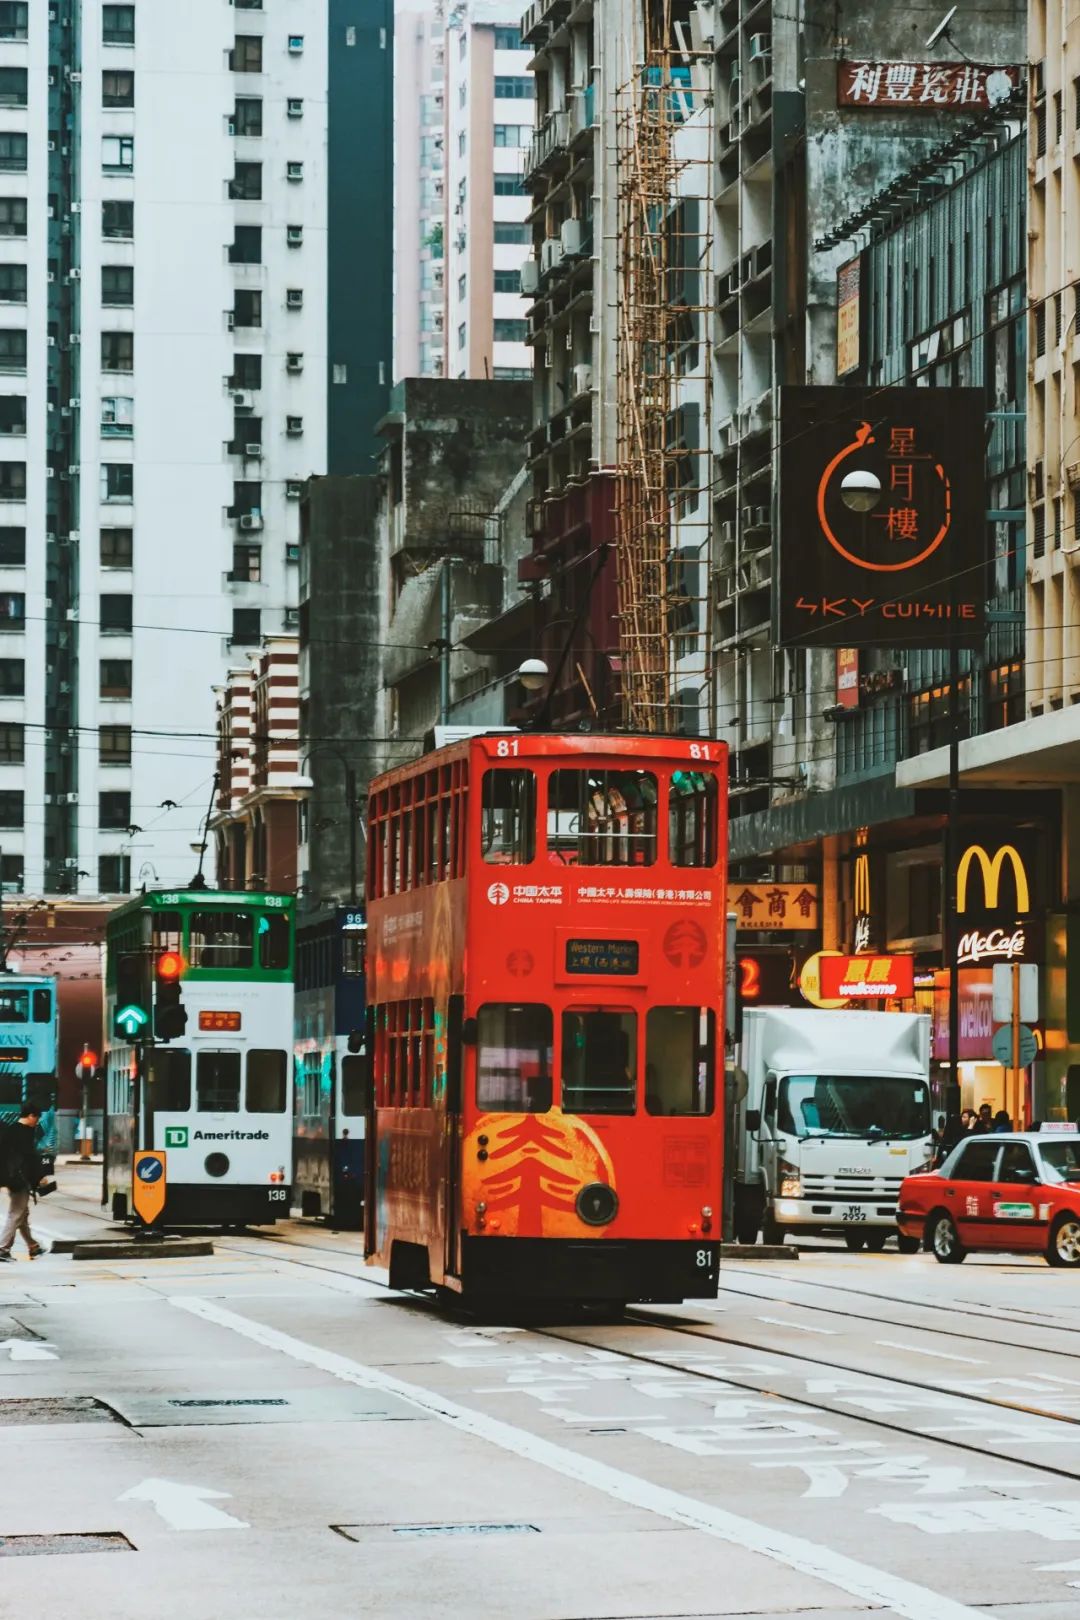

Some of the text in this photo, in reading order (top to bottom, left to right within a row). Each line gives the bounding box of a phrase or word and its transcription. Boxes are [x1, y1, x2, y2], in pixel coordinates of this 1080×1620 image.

[847, 64, 986, 104] 利豐瓷莊
[876, 427, 929, 541] 星月樓
[795, 597, 875, 616] SKY
[497, 740, 519, 757] 81
[689, 743, 711, 760] 81
[162, 894, 179, 904] 138
[264, 896, 282, 907] 138
[727, 887, 817, 919] 會商會
[346, 913, 362, 923] 96
[957, 929, 1025, 962] McCafé
[839, 981, 897, 996] wellcome
[167, 1129, 270, 1144] TD Ameritrade
[268, 1190, 286, 1200] 138
[696, 1250, 712, 1266] 81
